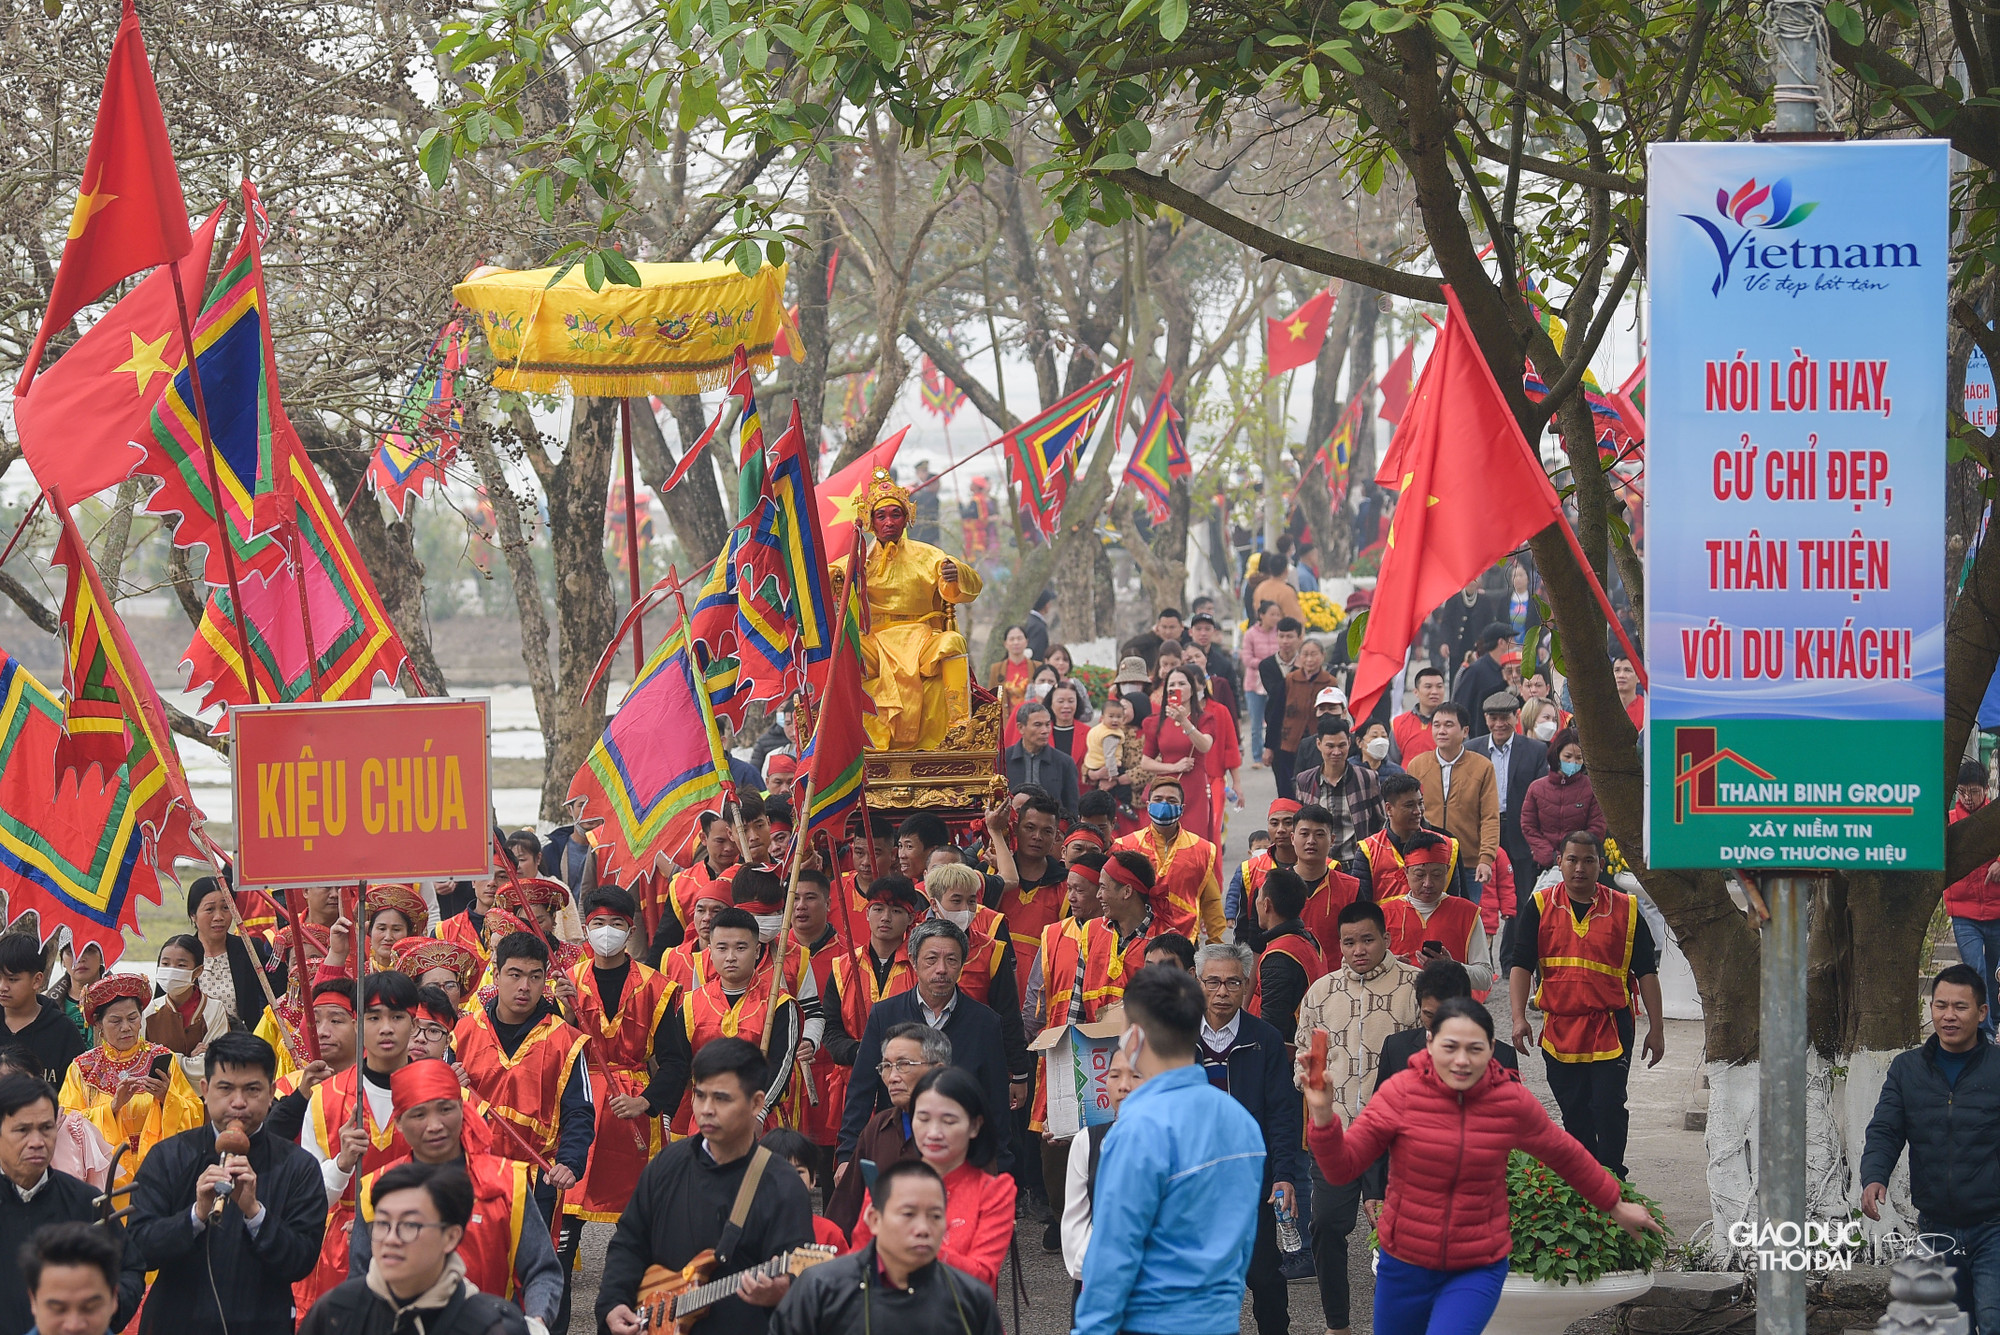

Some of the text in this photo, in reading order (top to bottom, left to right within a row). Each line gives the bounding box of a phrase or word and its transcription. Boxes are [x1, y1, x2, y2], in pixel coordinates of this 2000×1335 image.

[1677, 213, 1921, 298] Vietnam
[1775, 274, 1810, 299] đẹp
[1814, 273, 1845, 291] bất
[1846, 277, 1890, 293] tận
[1705, 348, 1892, 418] NÓI LỜI HAY,
[1964, 381, 1990, 400] HÁCH
[1713, 433, 1892, 512] CỬ CHỈ ĐẸP,
[1705, 529, 1889, 601] THÂN THIỆN
[1681, 618, 1912, 680] VỚI DU KHÁCH!
[257, 738, 468, 851] KIỆU CHÚA
[1719, 783, 1921, 803] THANH BINH GROUP
[1720, 843, 1907, 865] DỰNG THƯƠNG HIỆU
[1749, 817, 1873, 838] XÂY NIỀM TIN
